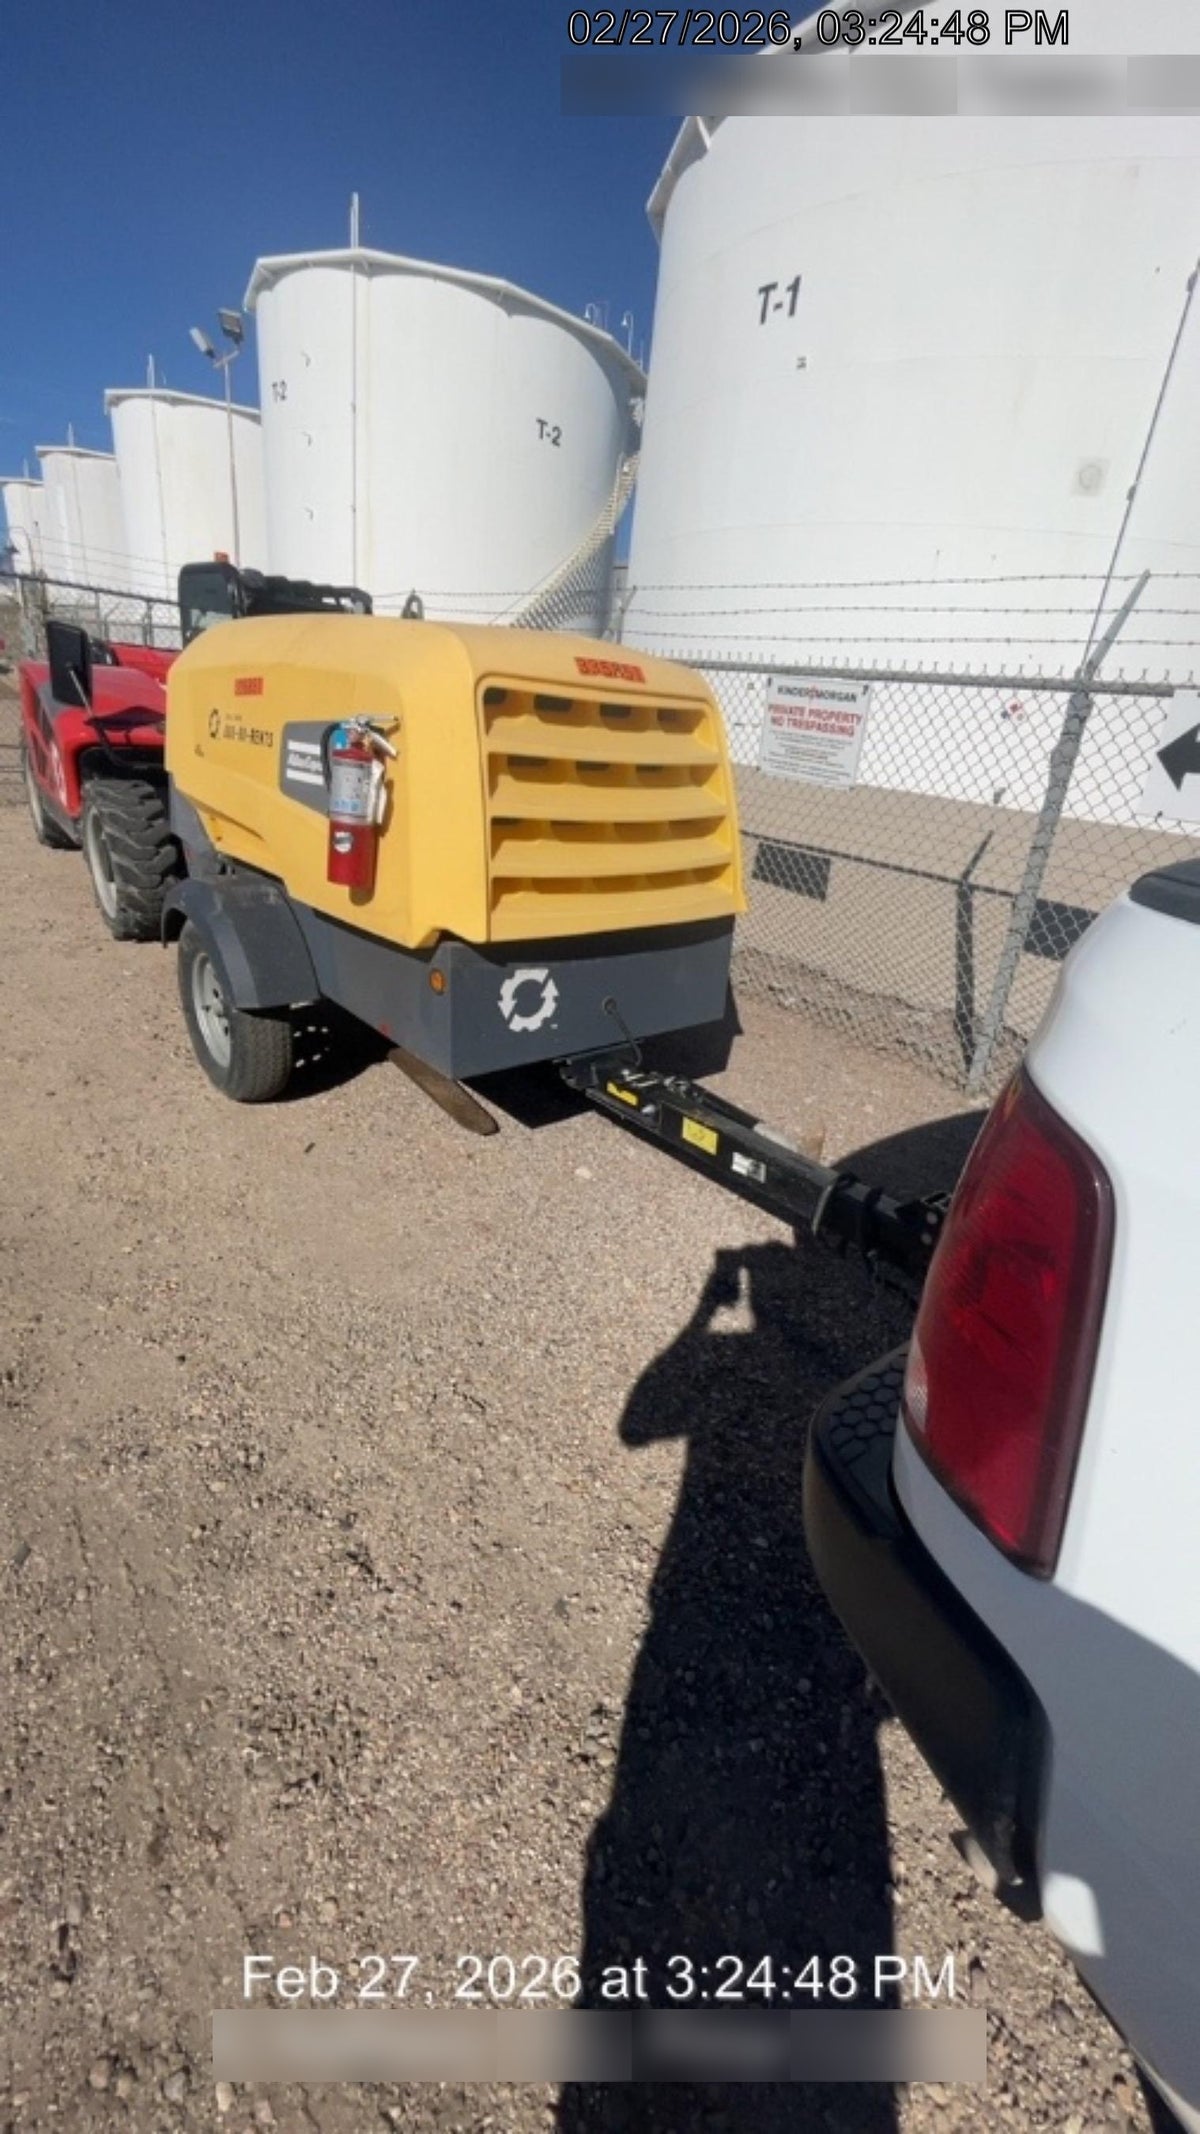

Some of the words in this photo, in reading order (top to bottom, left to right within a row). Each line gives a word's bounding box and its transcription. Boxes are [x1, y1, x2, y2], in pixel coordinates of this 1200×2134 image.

[758, 274, 802, 325] T-1
[535, 417, 562, 447] T-2
[770, 715, 784, 727] NO
[787, 717, 854, 737] TRESPASSING
[808, 708, 862, 725] PROPERTY
